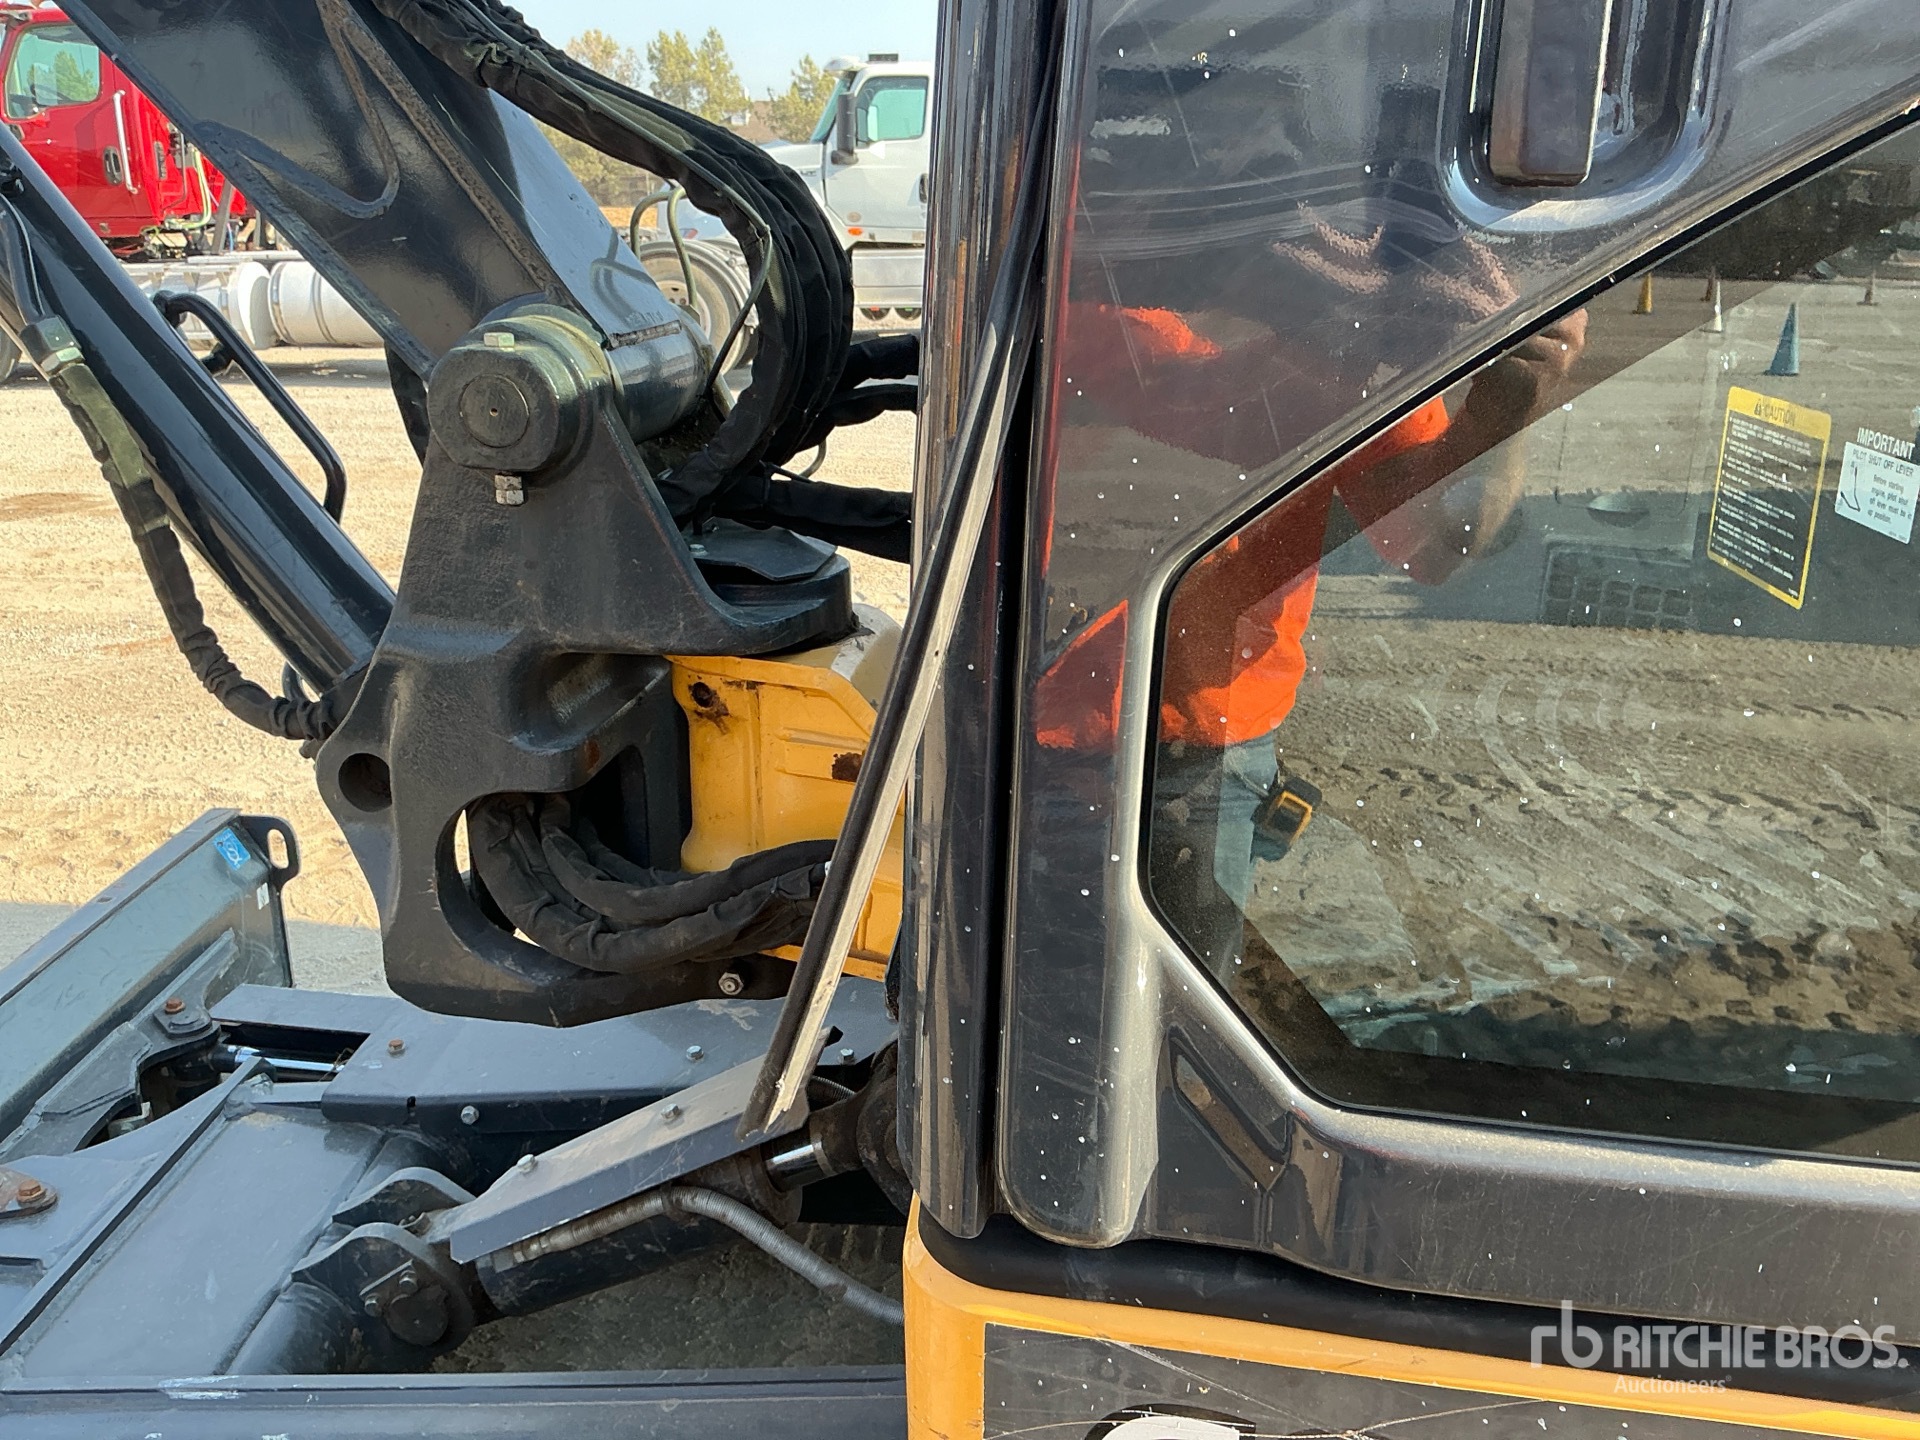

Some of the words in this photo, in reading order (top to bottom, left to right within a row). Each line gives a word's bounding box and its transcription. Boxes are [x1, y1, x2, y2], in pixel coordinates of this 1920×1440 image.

[1764, 402, 1796, 426] CAUTION
[1857, 427, 1915, 459] IMPORTANT
[1852, 448, 1867, 461] PILOT
[1868, 454, 1882, 467] SHUT
[1883, 459, 1894, 471] OFF
[1896, 462, 1914, 477] LEVER
